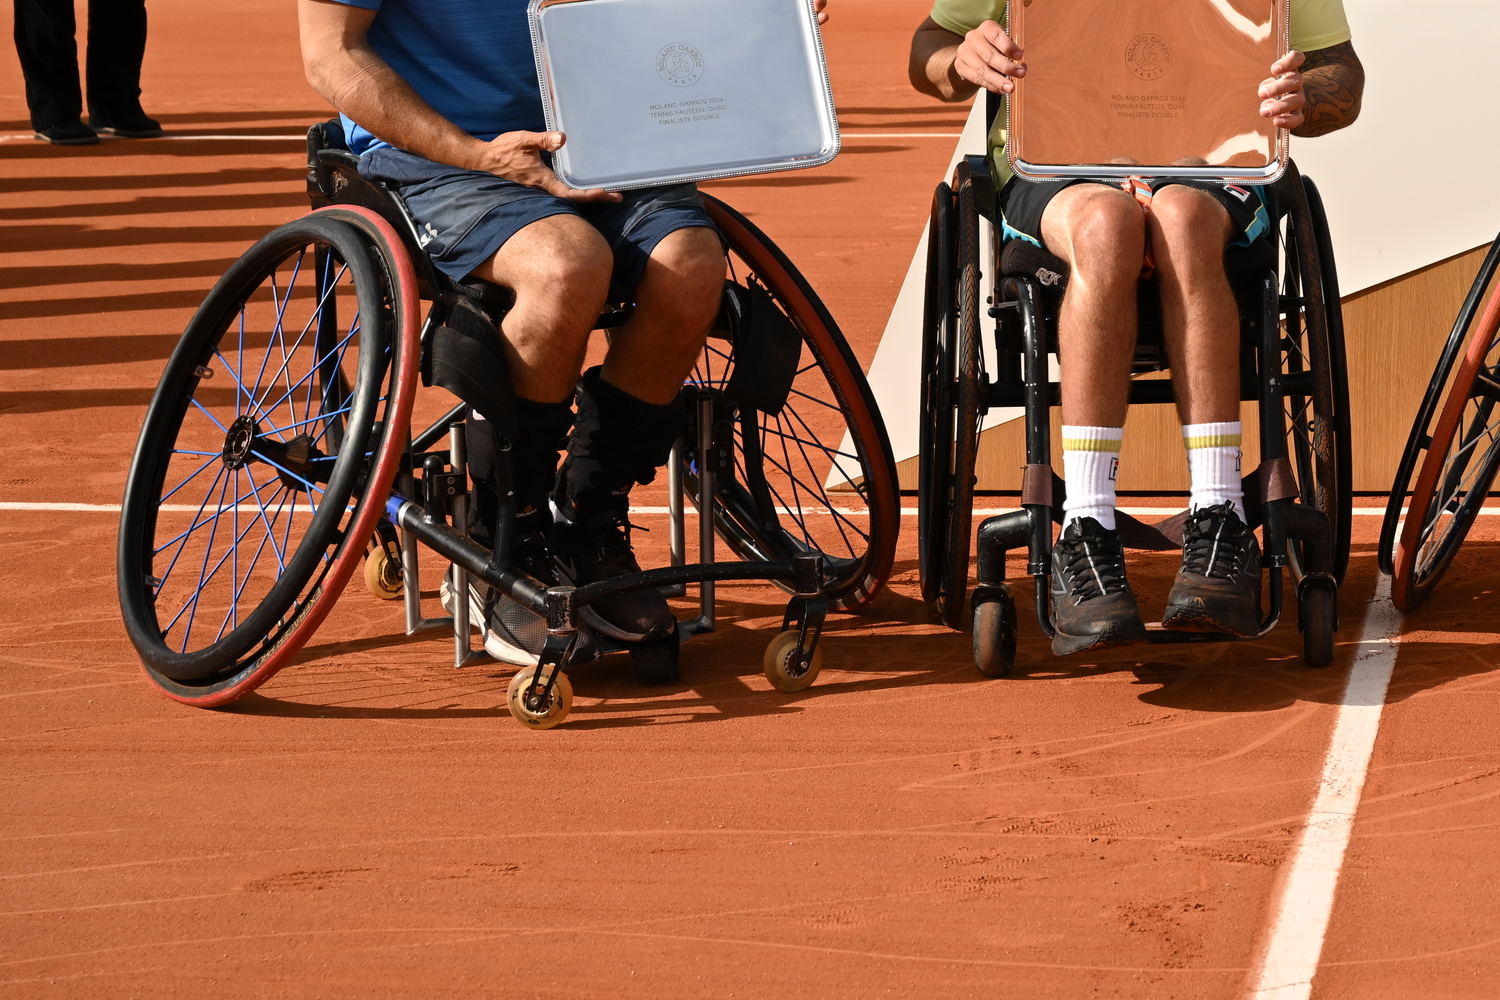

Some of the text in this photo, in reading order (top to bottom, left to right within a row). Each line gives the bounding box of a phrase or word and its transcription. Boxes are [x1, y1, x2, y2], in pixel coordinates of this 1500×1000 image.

[657, 45, 676, 72] ROLAND
[1127, 36, 1148, 62] ROLAND
[650, 102, 678, 111] ROLAND
[679, 98, 707, 108] GARROS
[659, 112, 721, 126] FINALISTE DOUBLE
